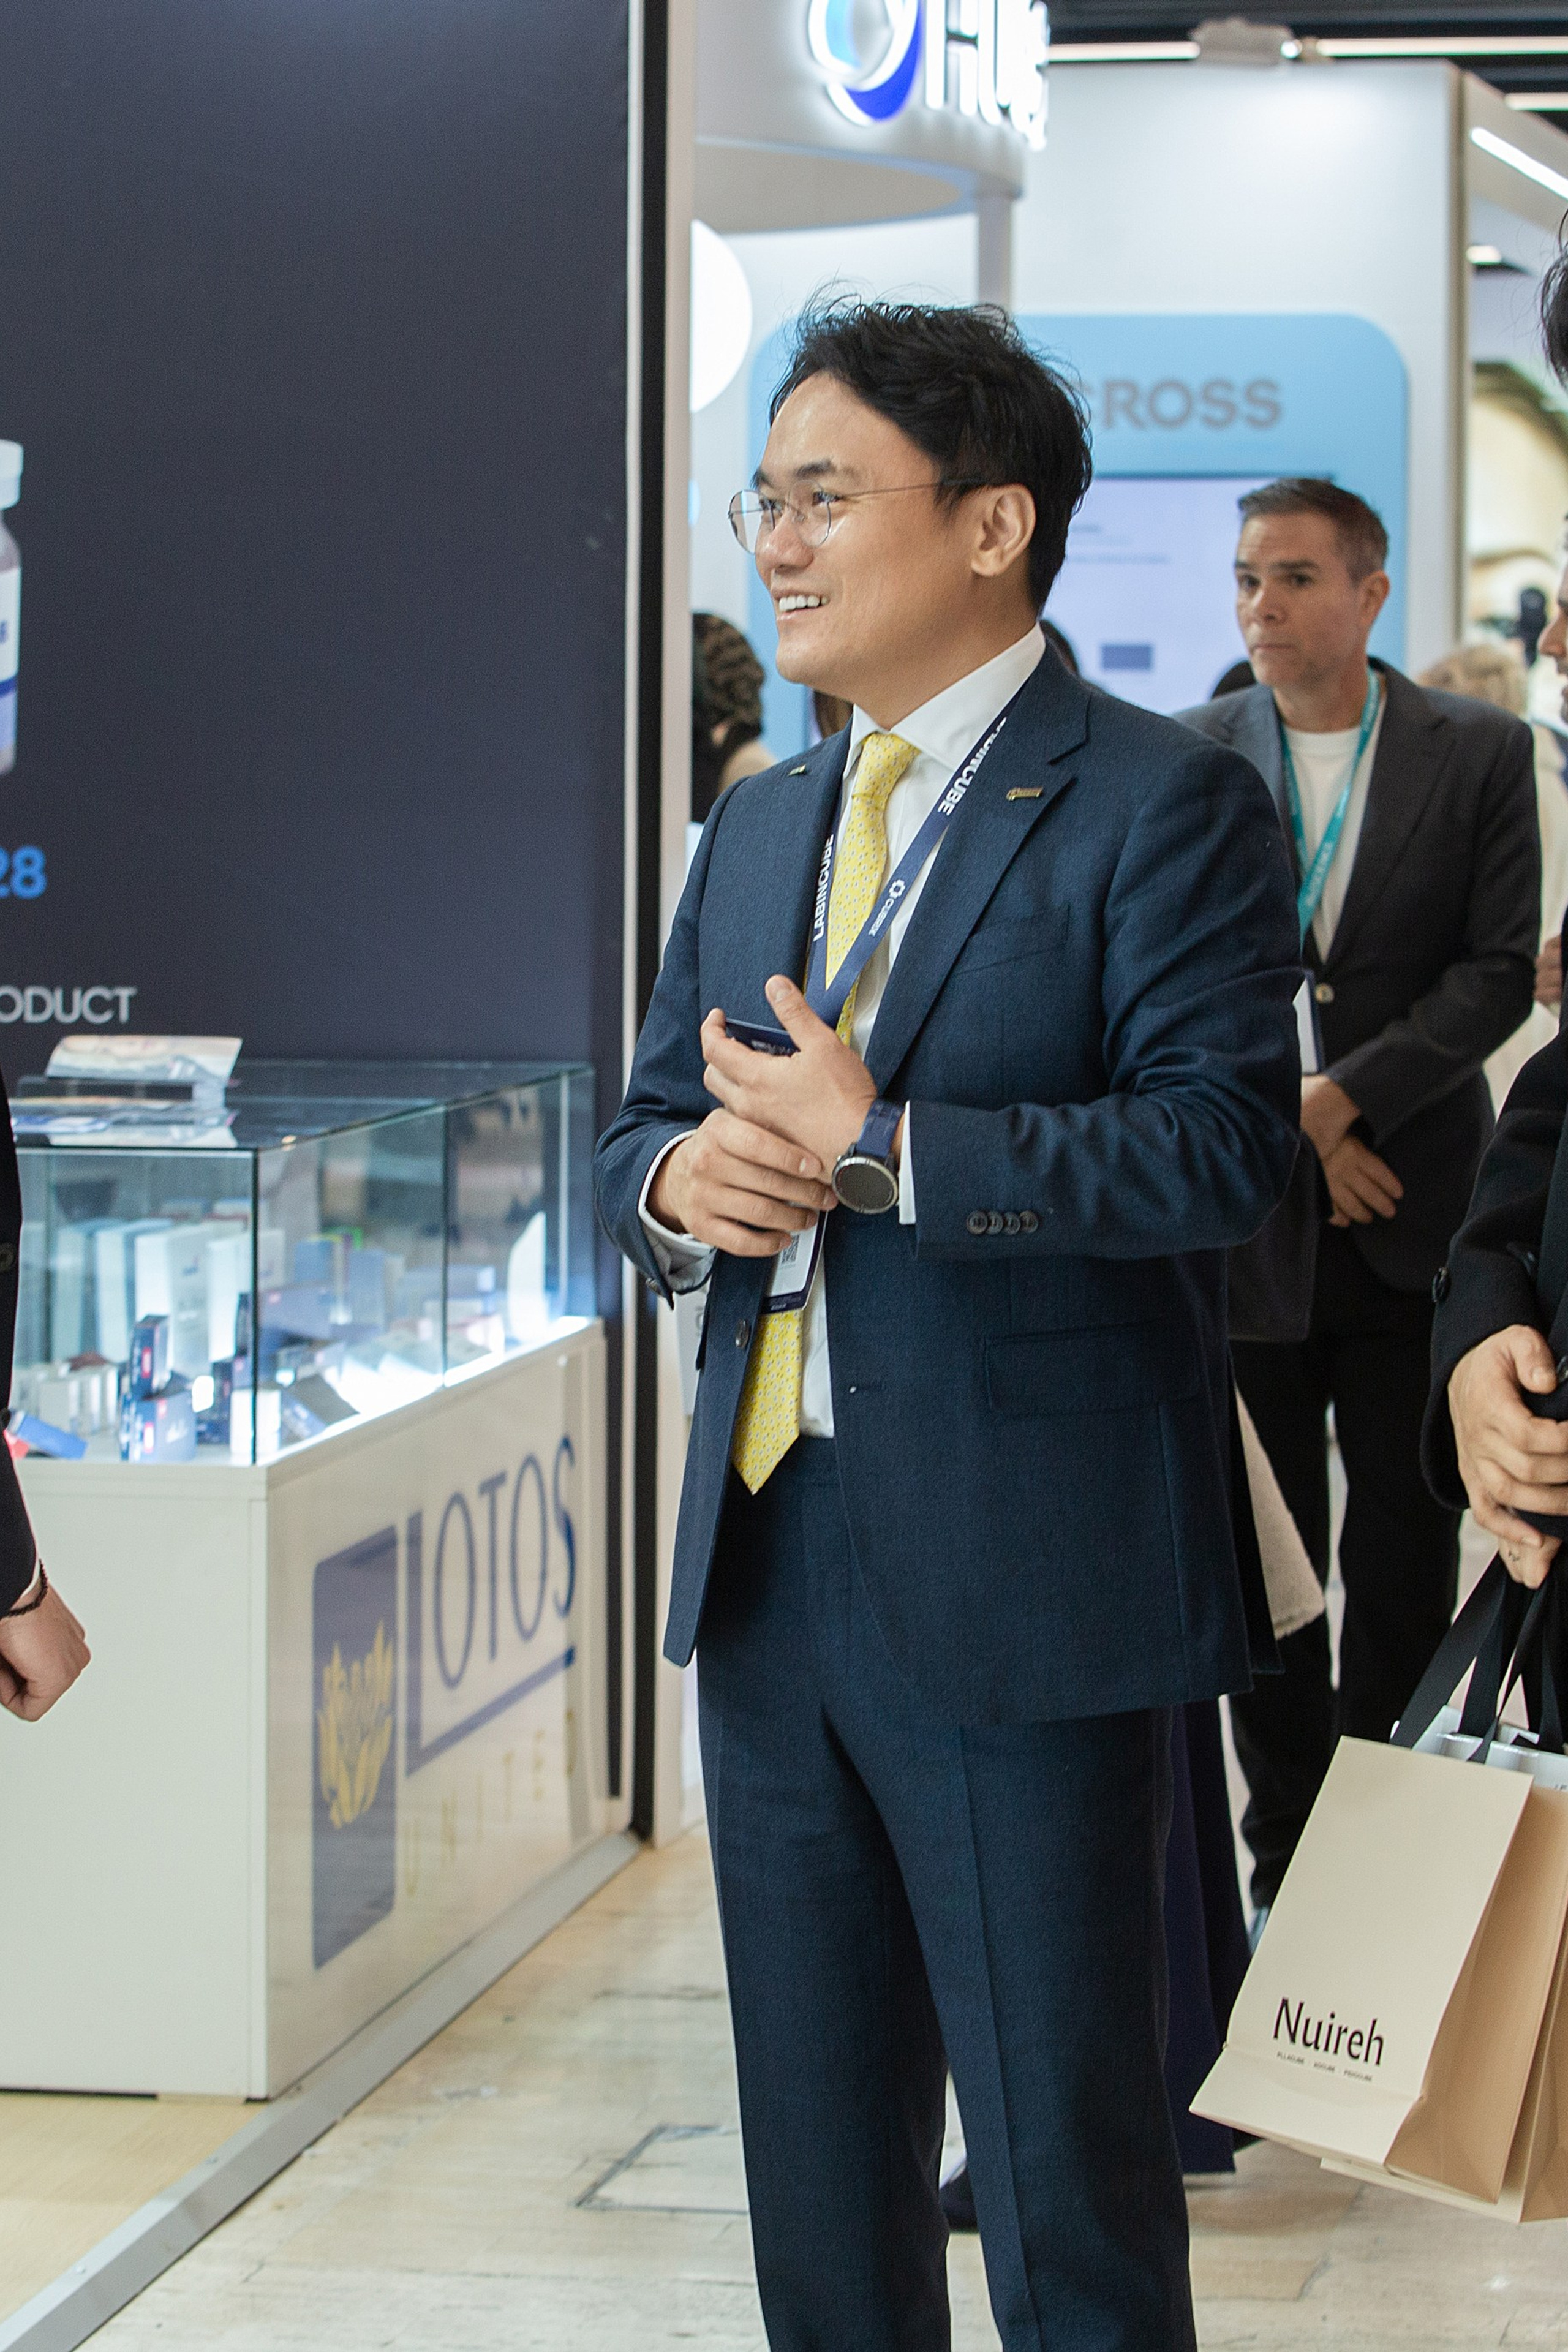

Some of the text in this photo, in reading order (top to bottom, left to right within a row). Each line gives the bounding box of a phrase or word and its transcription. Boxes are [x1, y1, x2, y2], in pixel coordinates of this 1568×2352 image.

[1076, 377, 1281, 431] ROSS
[405, 1433, 576, 1777] LOTOS
[404, 1708, 576, 1898] UNITED
[1273, 1996, 1384, 2067] Nuireh
